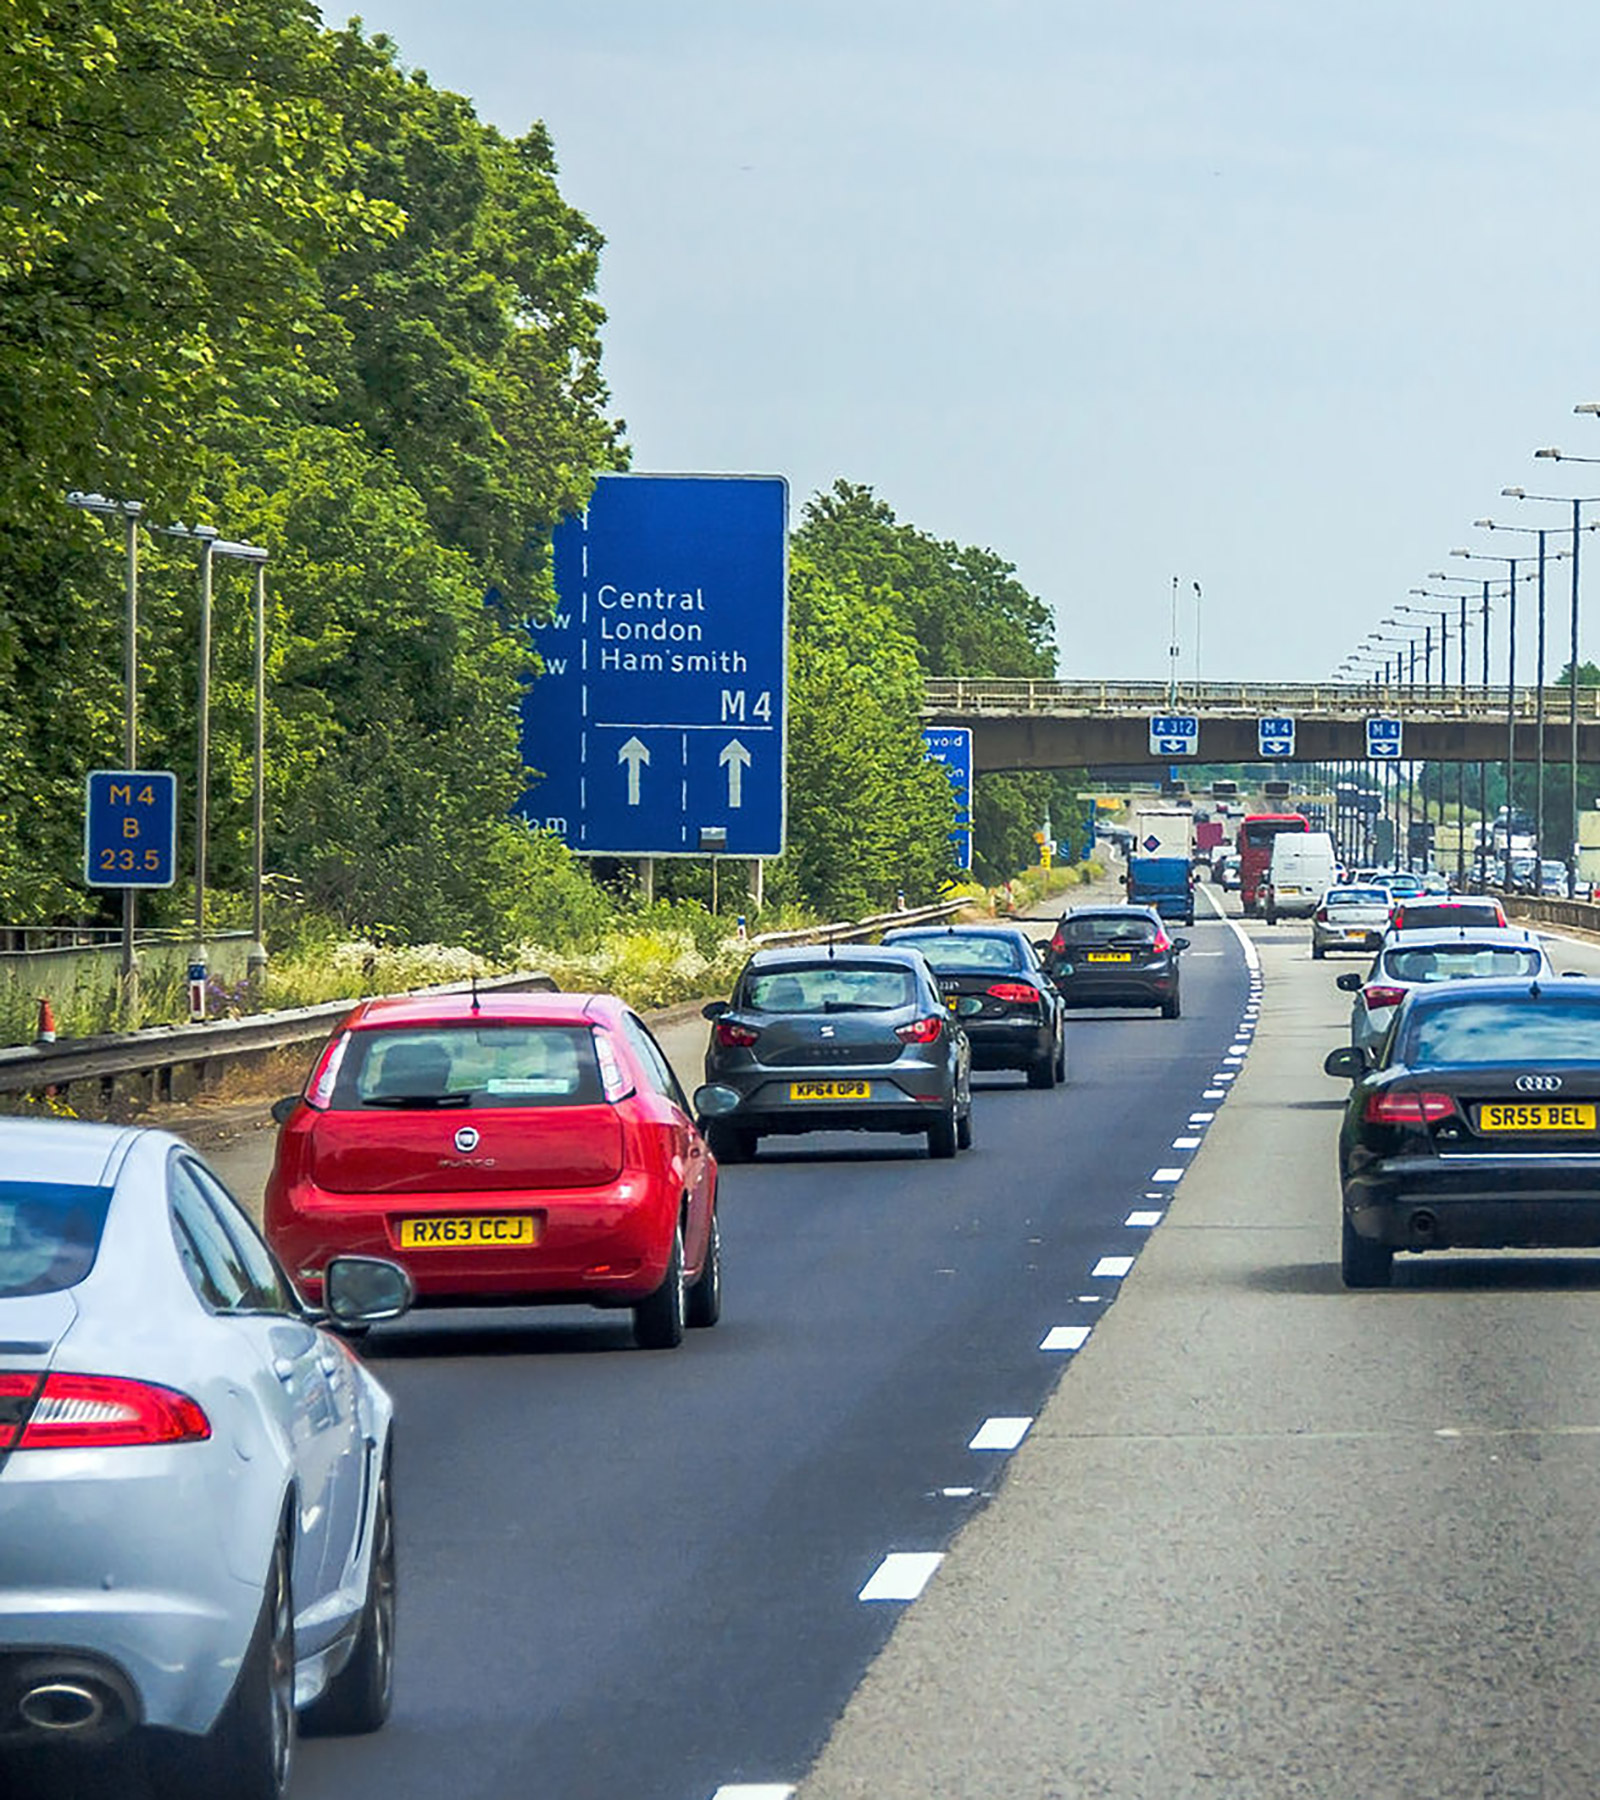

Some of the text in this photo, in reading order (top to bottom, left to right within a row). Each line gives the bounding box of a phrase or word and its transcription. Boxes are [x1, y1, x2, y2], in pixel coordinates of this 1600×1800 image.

[598, 584, 705, 611] Central
[601, 616, 702, 641] London
[601, 648, 747, 673] Ham'smith
[123, 817, 139, 838] B
[100, 847, 160, 870] 23.5
[1490, 1107, 1586, 1126] SR55 BEL
[413, 1219, 524, 1242] RX63 CCJ
